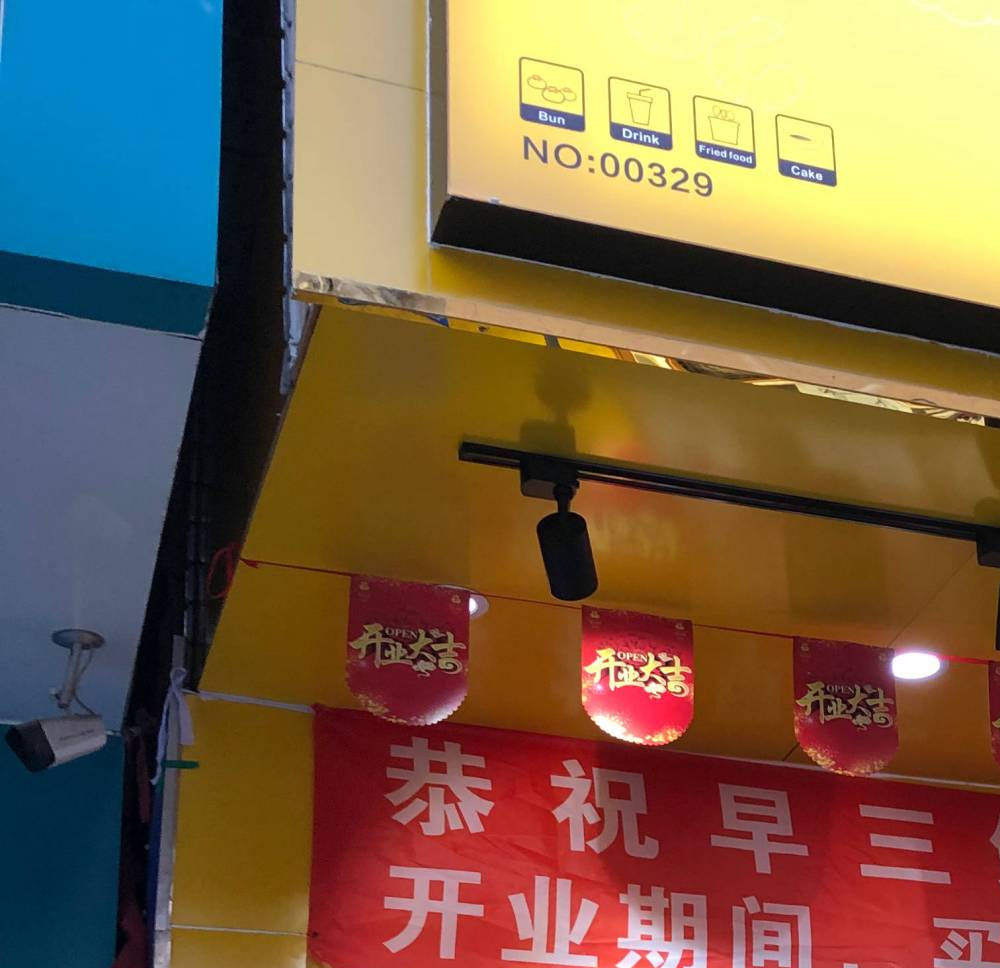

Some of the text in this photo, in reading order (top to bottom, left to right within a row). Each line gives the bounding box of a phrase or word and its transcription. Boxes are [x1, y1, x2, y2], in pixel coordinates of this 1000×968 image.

[537, 109, 566, 126] Bun
[622, 127, 661, 146] Drink
[698, 144, 753, 164] Fried food
[522, 135, 714, 197] NO:00329
[791, 165, 824, 181] Cake
[385, 626, 418, 640] OPEN
[350, 623, 466, 676] 开业大吉
[616, 650, 649, 665] OPEN
[584, 647, 692, 698] 开业大吉
[826, 683, 856, 695] OPEN
[796, 680, 894, 728] 开业大吉
